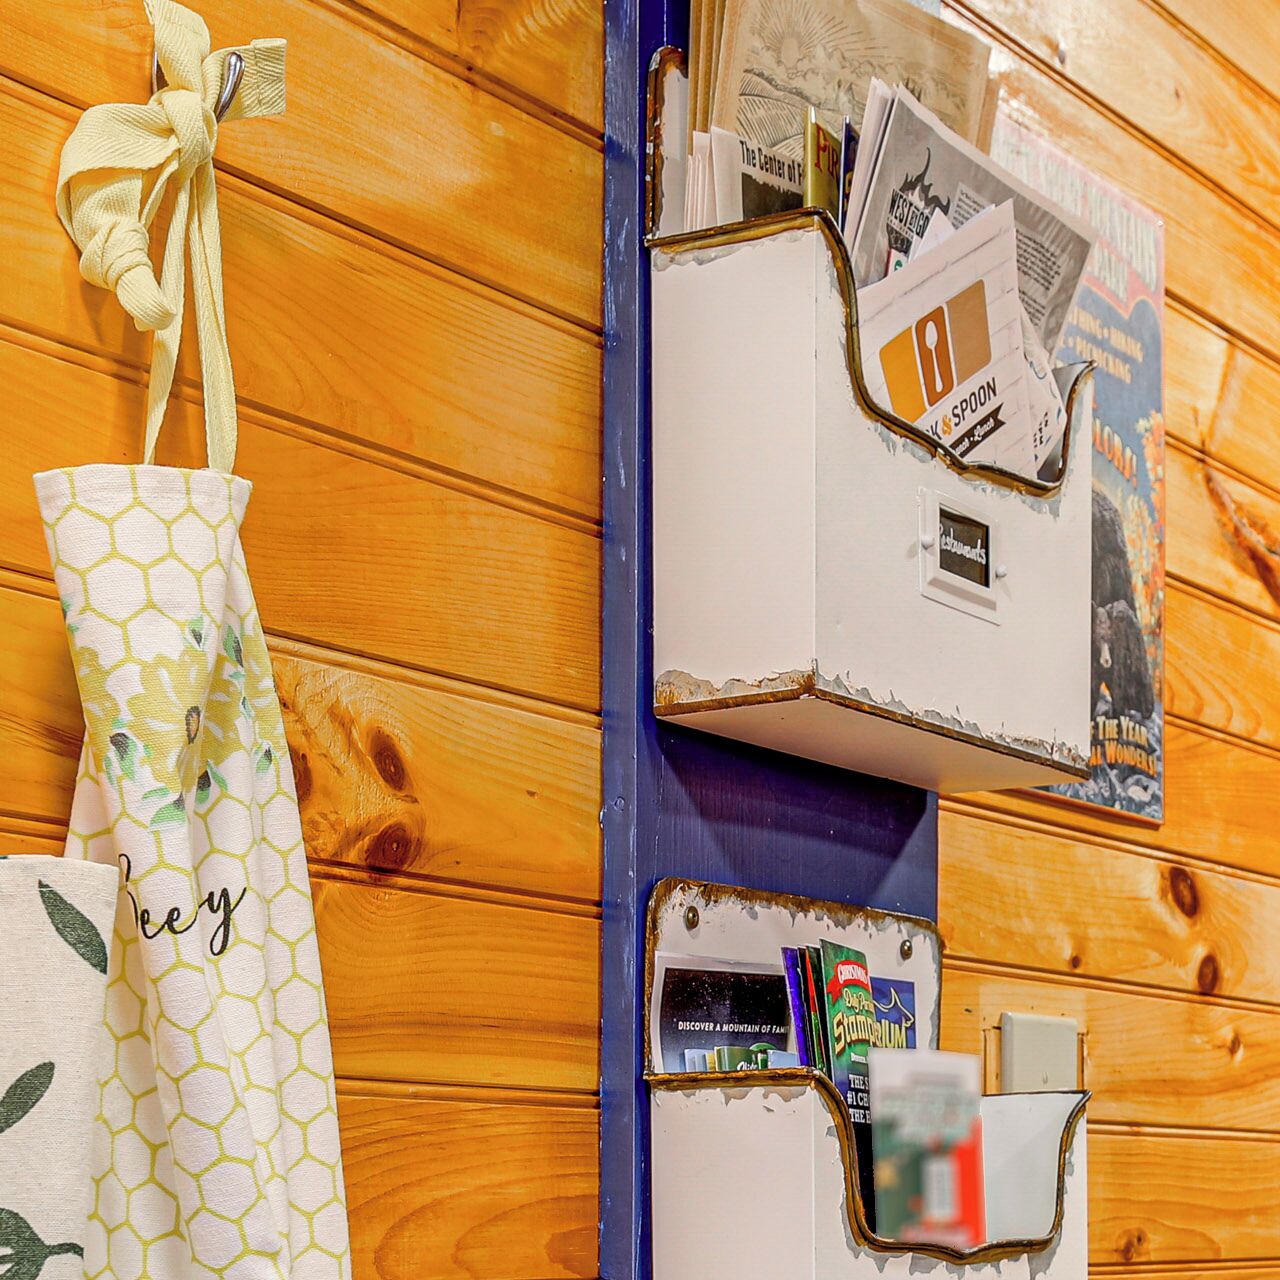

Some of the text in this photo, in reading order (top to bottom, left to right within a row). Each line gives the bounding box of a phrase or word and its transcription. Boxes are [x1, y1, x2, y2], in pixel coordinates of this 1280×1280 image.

[739, 140, 757, 168] The
[758, 147, 786, 179] Center
[787, 159, 797, 183] of
[889, 188, 913, 227] WEST
[951, 376, 997, 427] SPOON
[1096, 714, 1119, 740] THE
[837, 963, 868, 985] CHRISTMAS
[677, 1020, 714, 1032] DISCOVER
[715, 1023, 721, 1032] A
[722, 1023, 760, 1034] MOUNTAIN
[761, 1024, 771, 1034] OF
[834, 1012, 876, 1056] Stamp
[849, 1074, 865, 1089] THE
[847, 1091, 857, 1106] #1
[849, 1108, 865, 1123] THE
